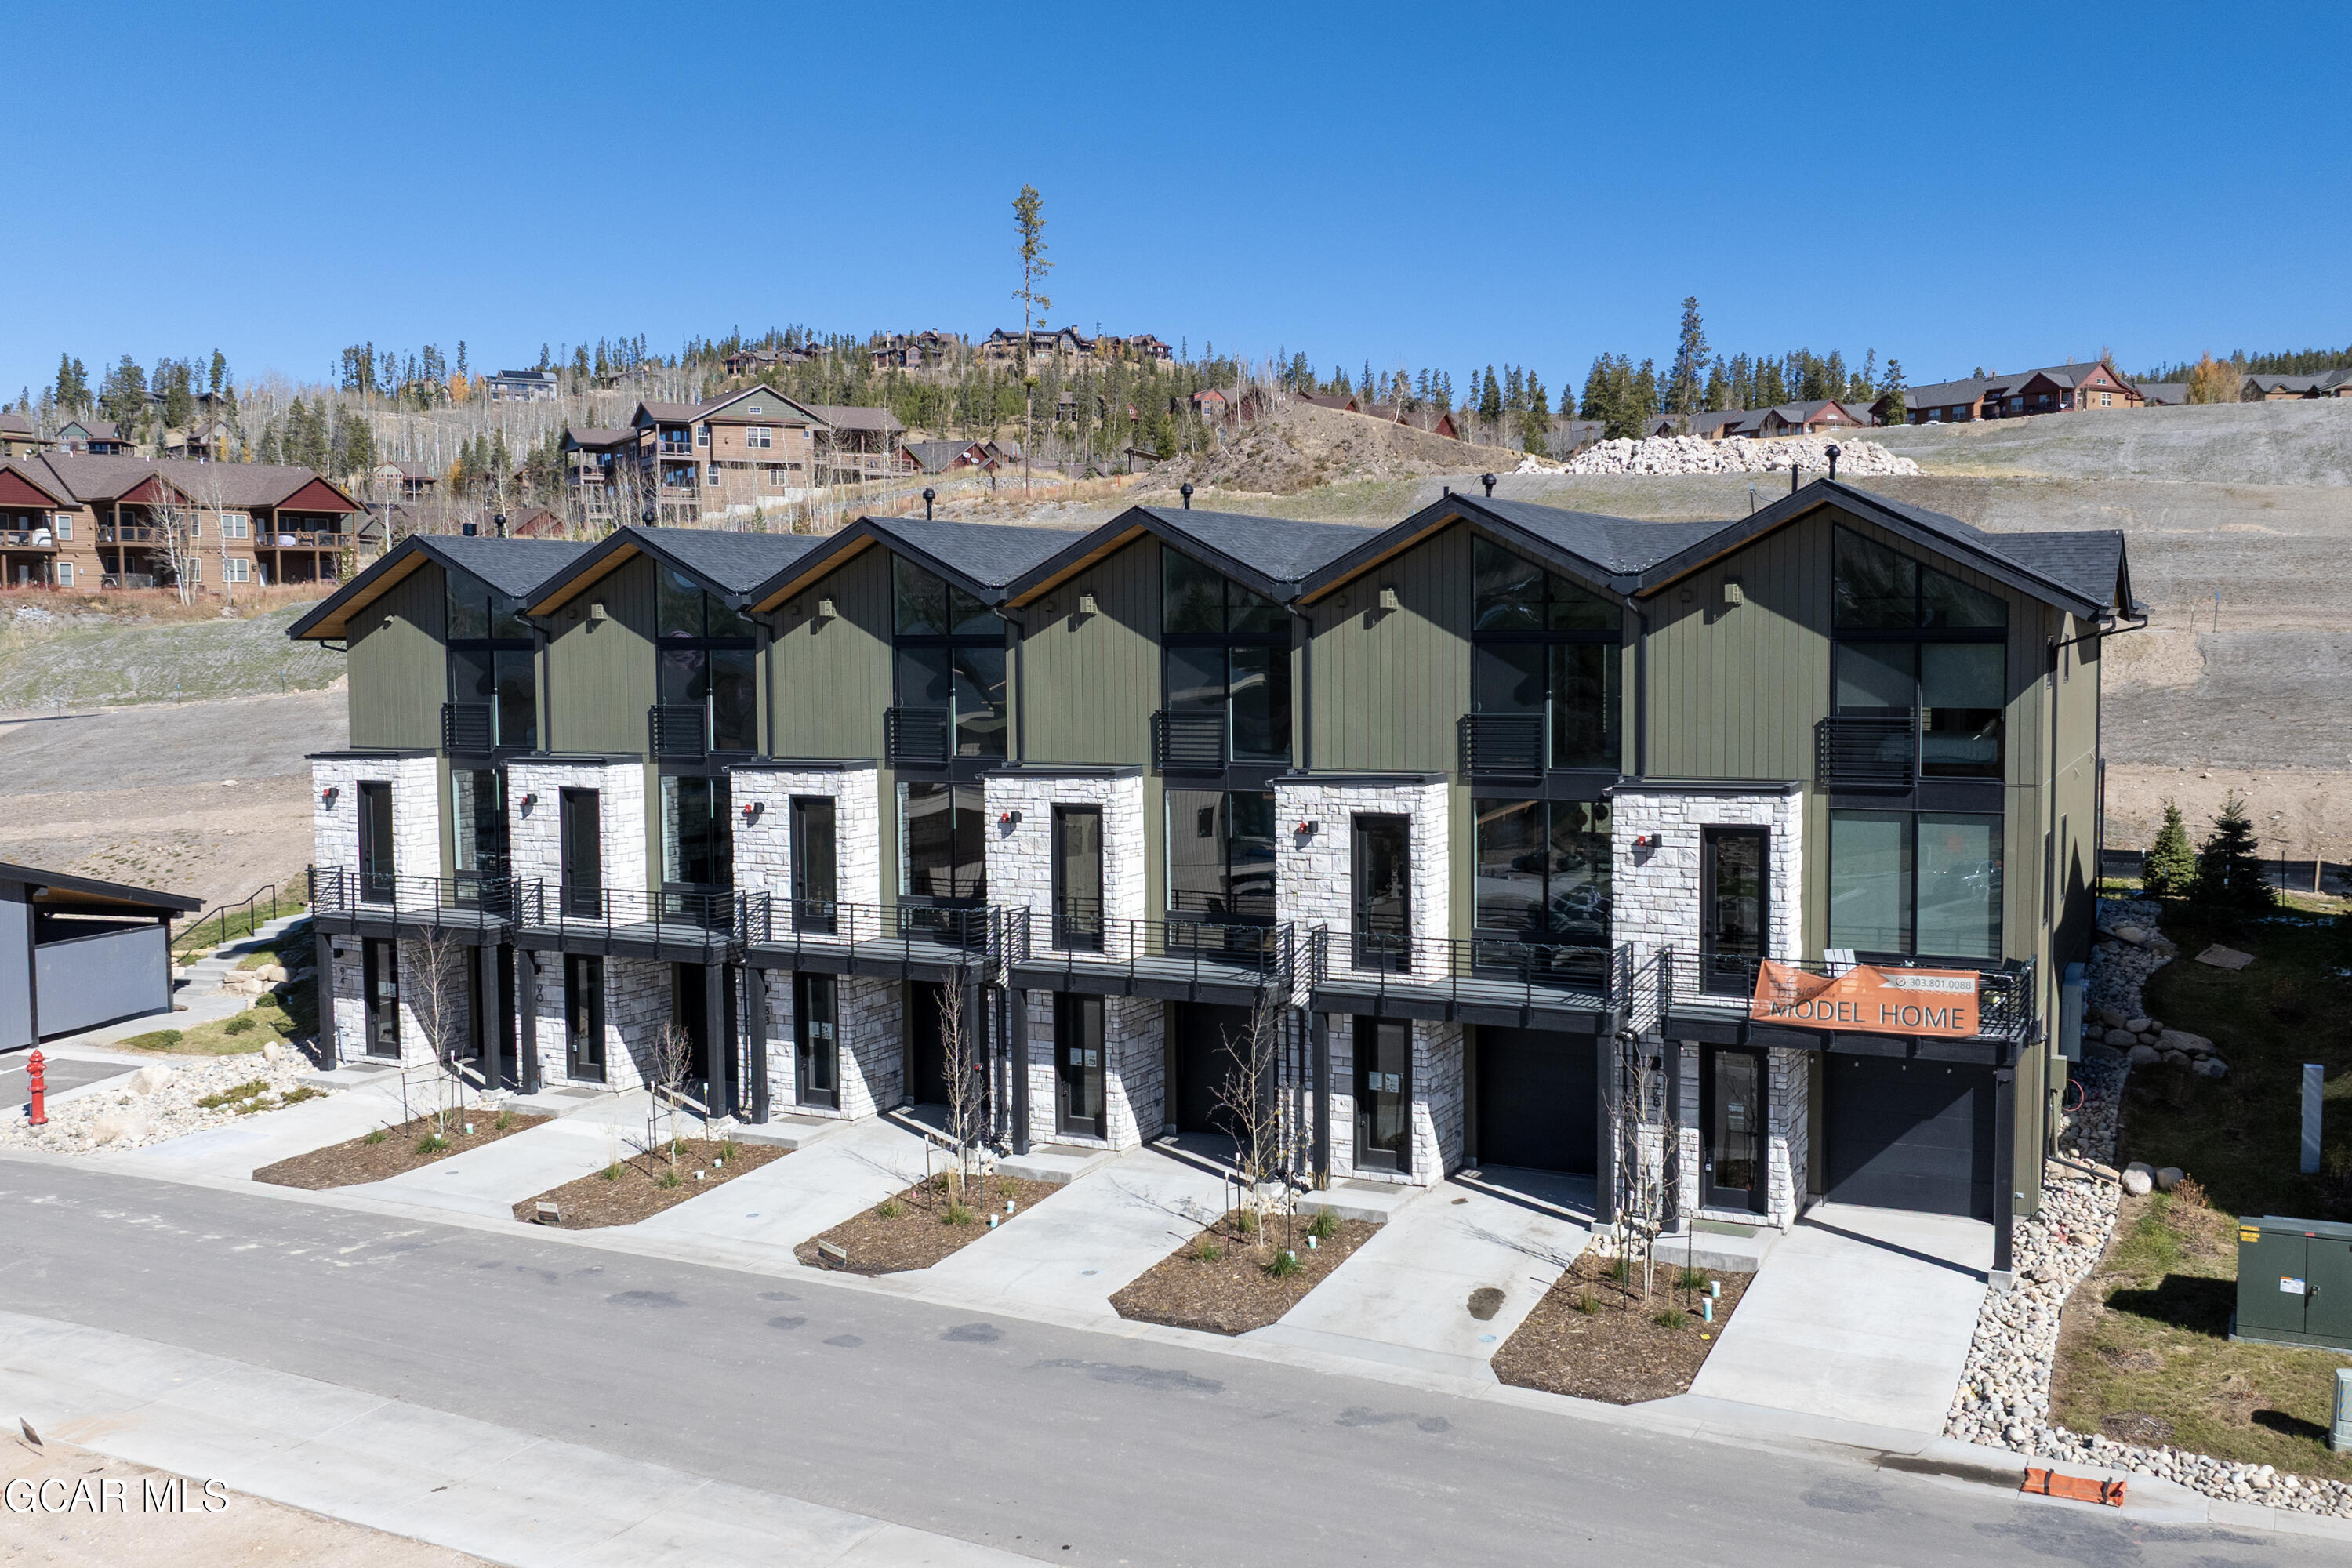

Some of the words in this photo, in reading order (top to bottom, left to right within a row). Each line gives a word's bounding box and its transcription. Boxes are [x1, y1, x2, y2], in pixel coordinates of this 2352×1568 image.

[339, 967, 345, 984] 94
[1910, 978, 1971, 989] 303.801.0088
[536, 984, 544, 1002] 90
[1769, 1000, 1865, 1023] MODEL
[1879, 1004, 1965, 1029] HOME
